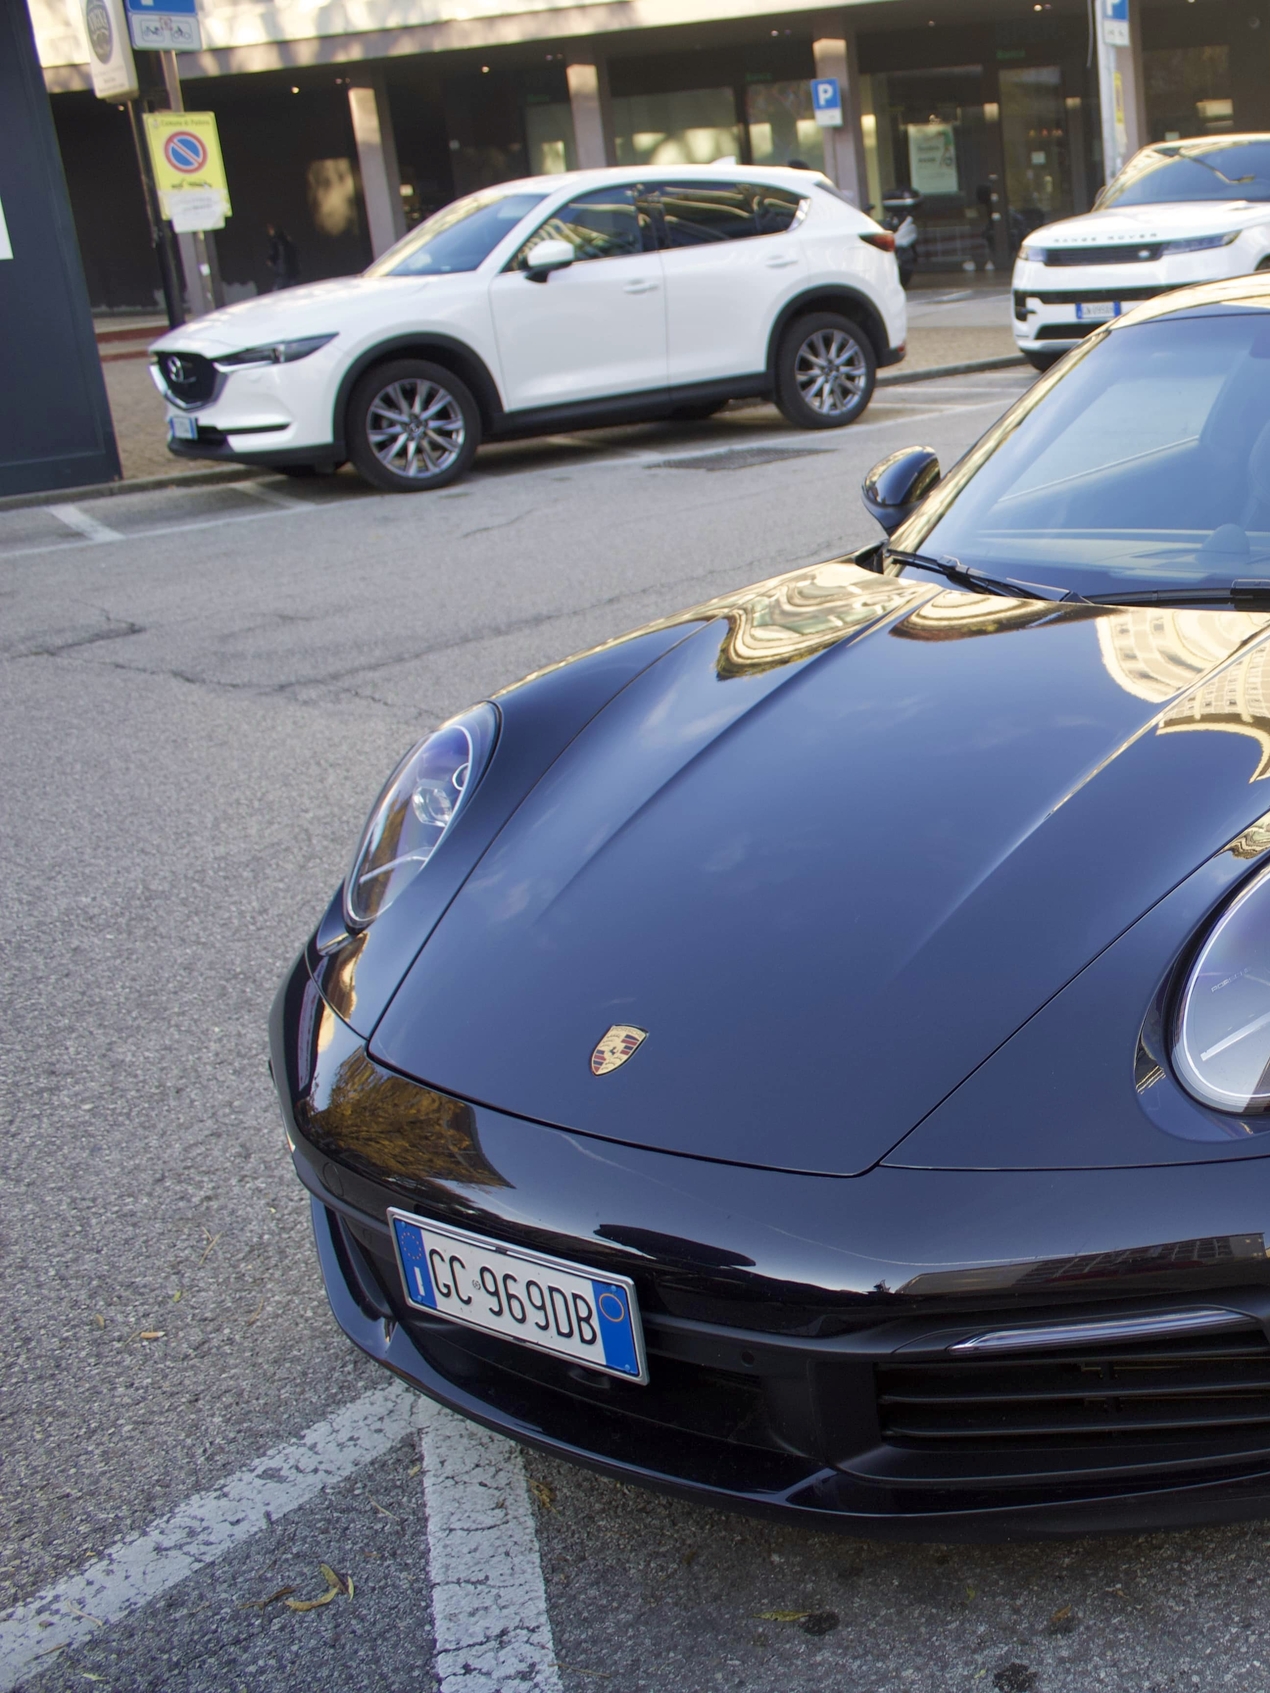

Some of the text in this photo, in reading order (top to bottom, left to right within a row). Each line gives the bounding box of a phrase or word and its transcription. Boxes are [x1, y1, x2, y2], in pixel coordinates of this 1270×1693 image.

[817, 83, 833, 106] P
[1107, 232, 1158, 241] ROVER
[429, 1248, 598, 1345] GC 969DB
